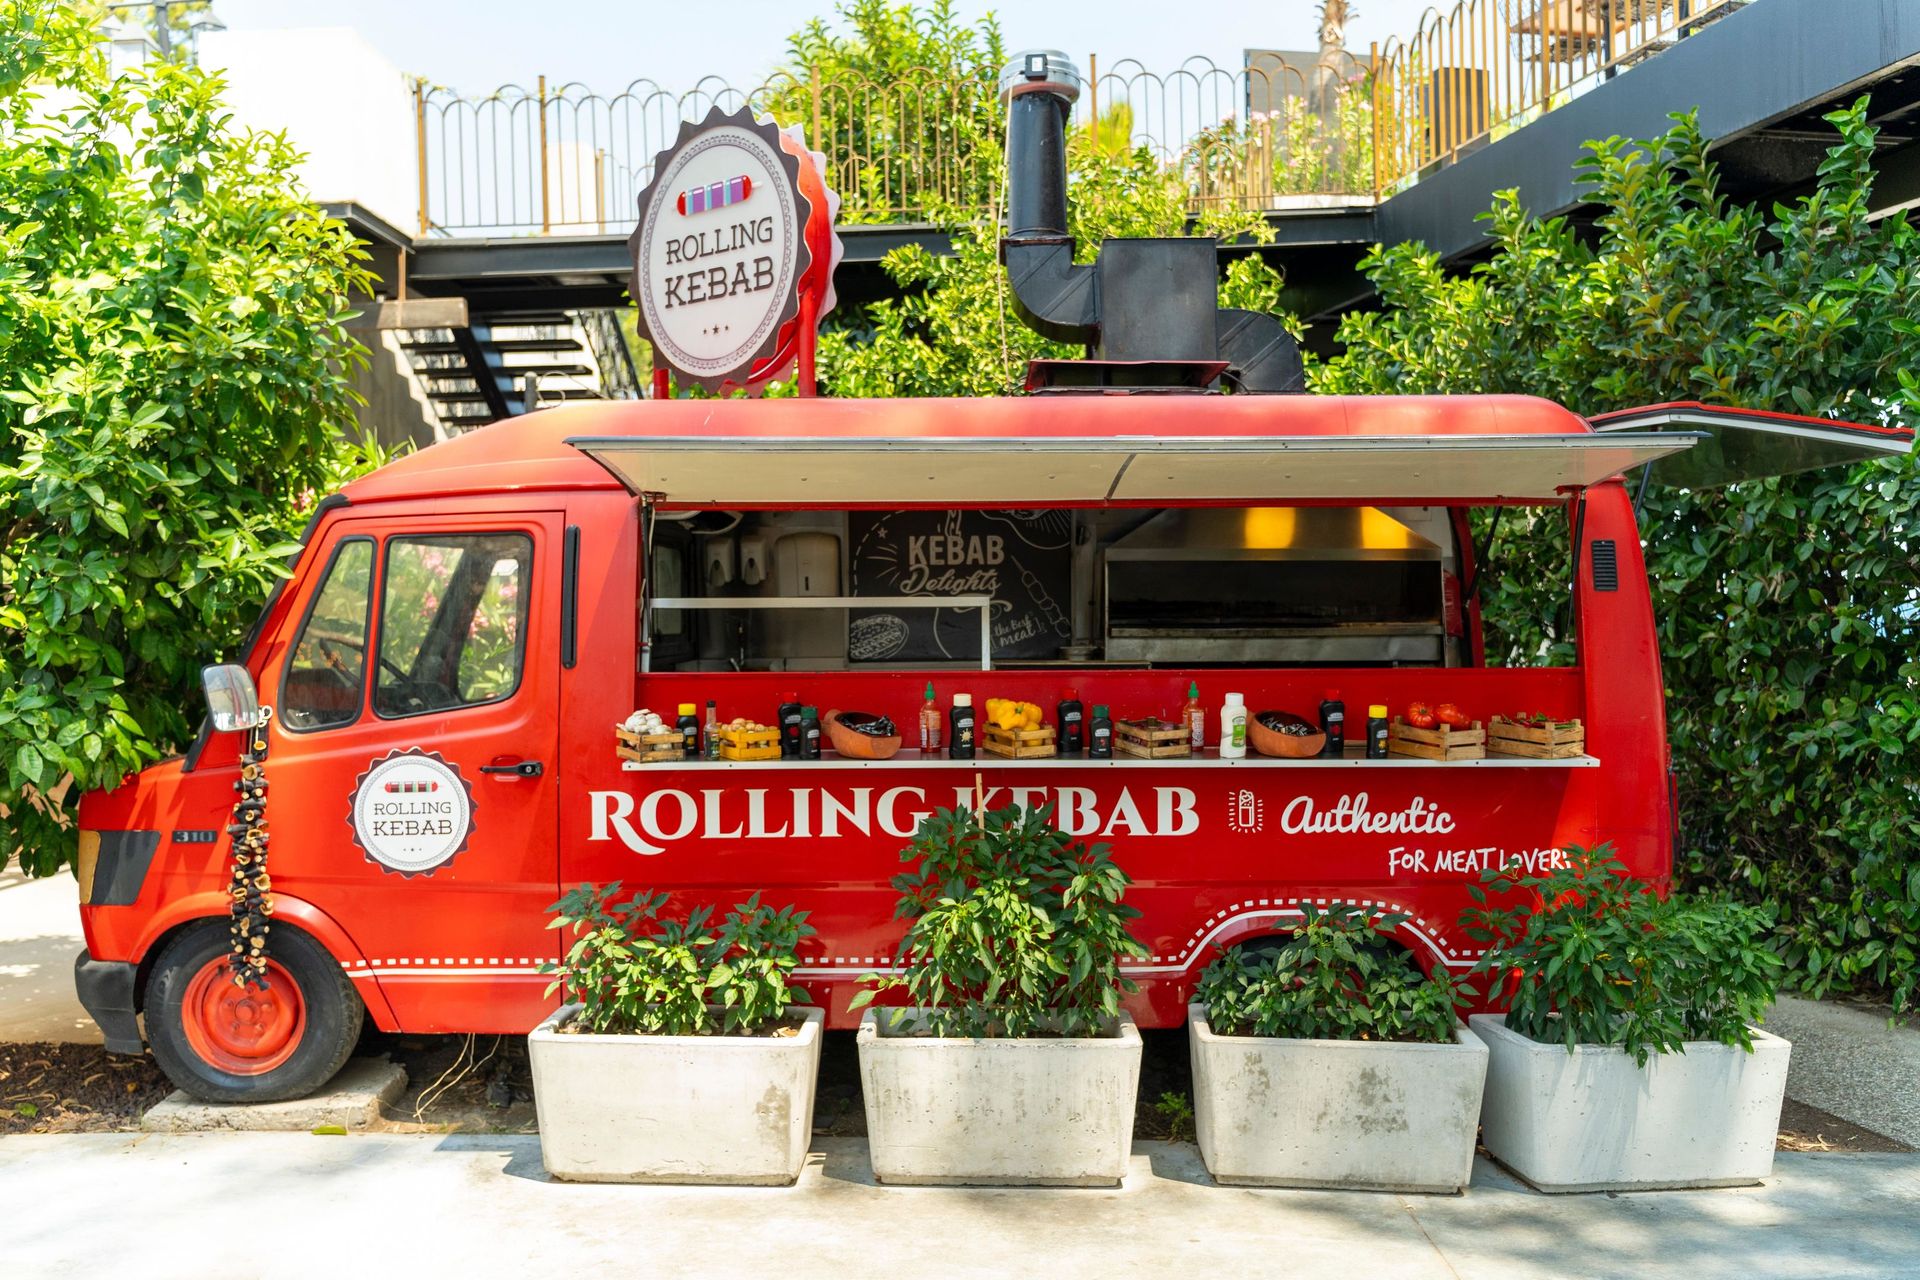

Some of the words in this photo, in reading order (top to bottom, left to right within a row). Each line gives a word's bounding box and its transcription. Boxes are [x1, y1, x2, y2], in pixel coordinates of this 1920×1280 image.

[666, 216, 774, 265] ROLLING
[665, 256, 775, 309] KEBAB
[909, 535, 1005, 565] KEBAB
[900, 563, 1002, 597] Delights
[374, 802, 451, 815] ROLLING
[587, 786, 933, 856] ROLLING
[1281, 792, 1456, 834] Authentic
[176, 831, 213, 842] 310
[373, 820, 453, 836] KEBAB
[1389, 847, 1430, 876] FOR
[1434, 847, 1497, 873] MEAT
